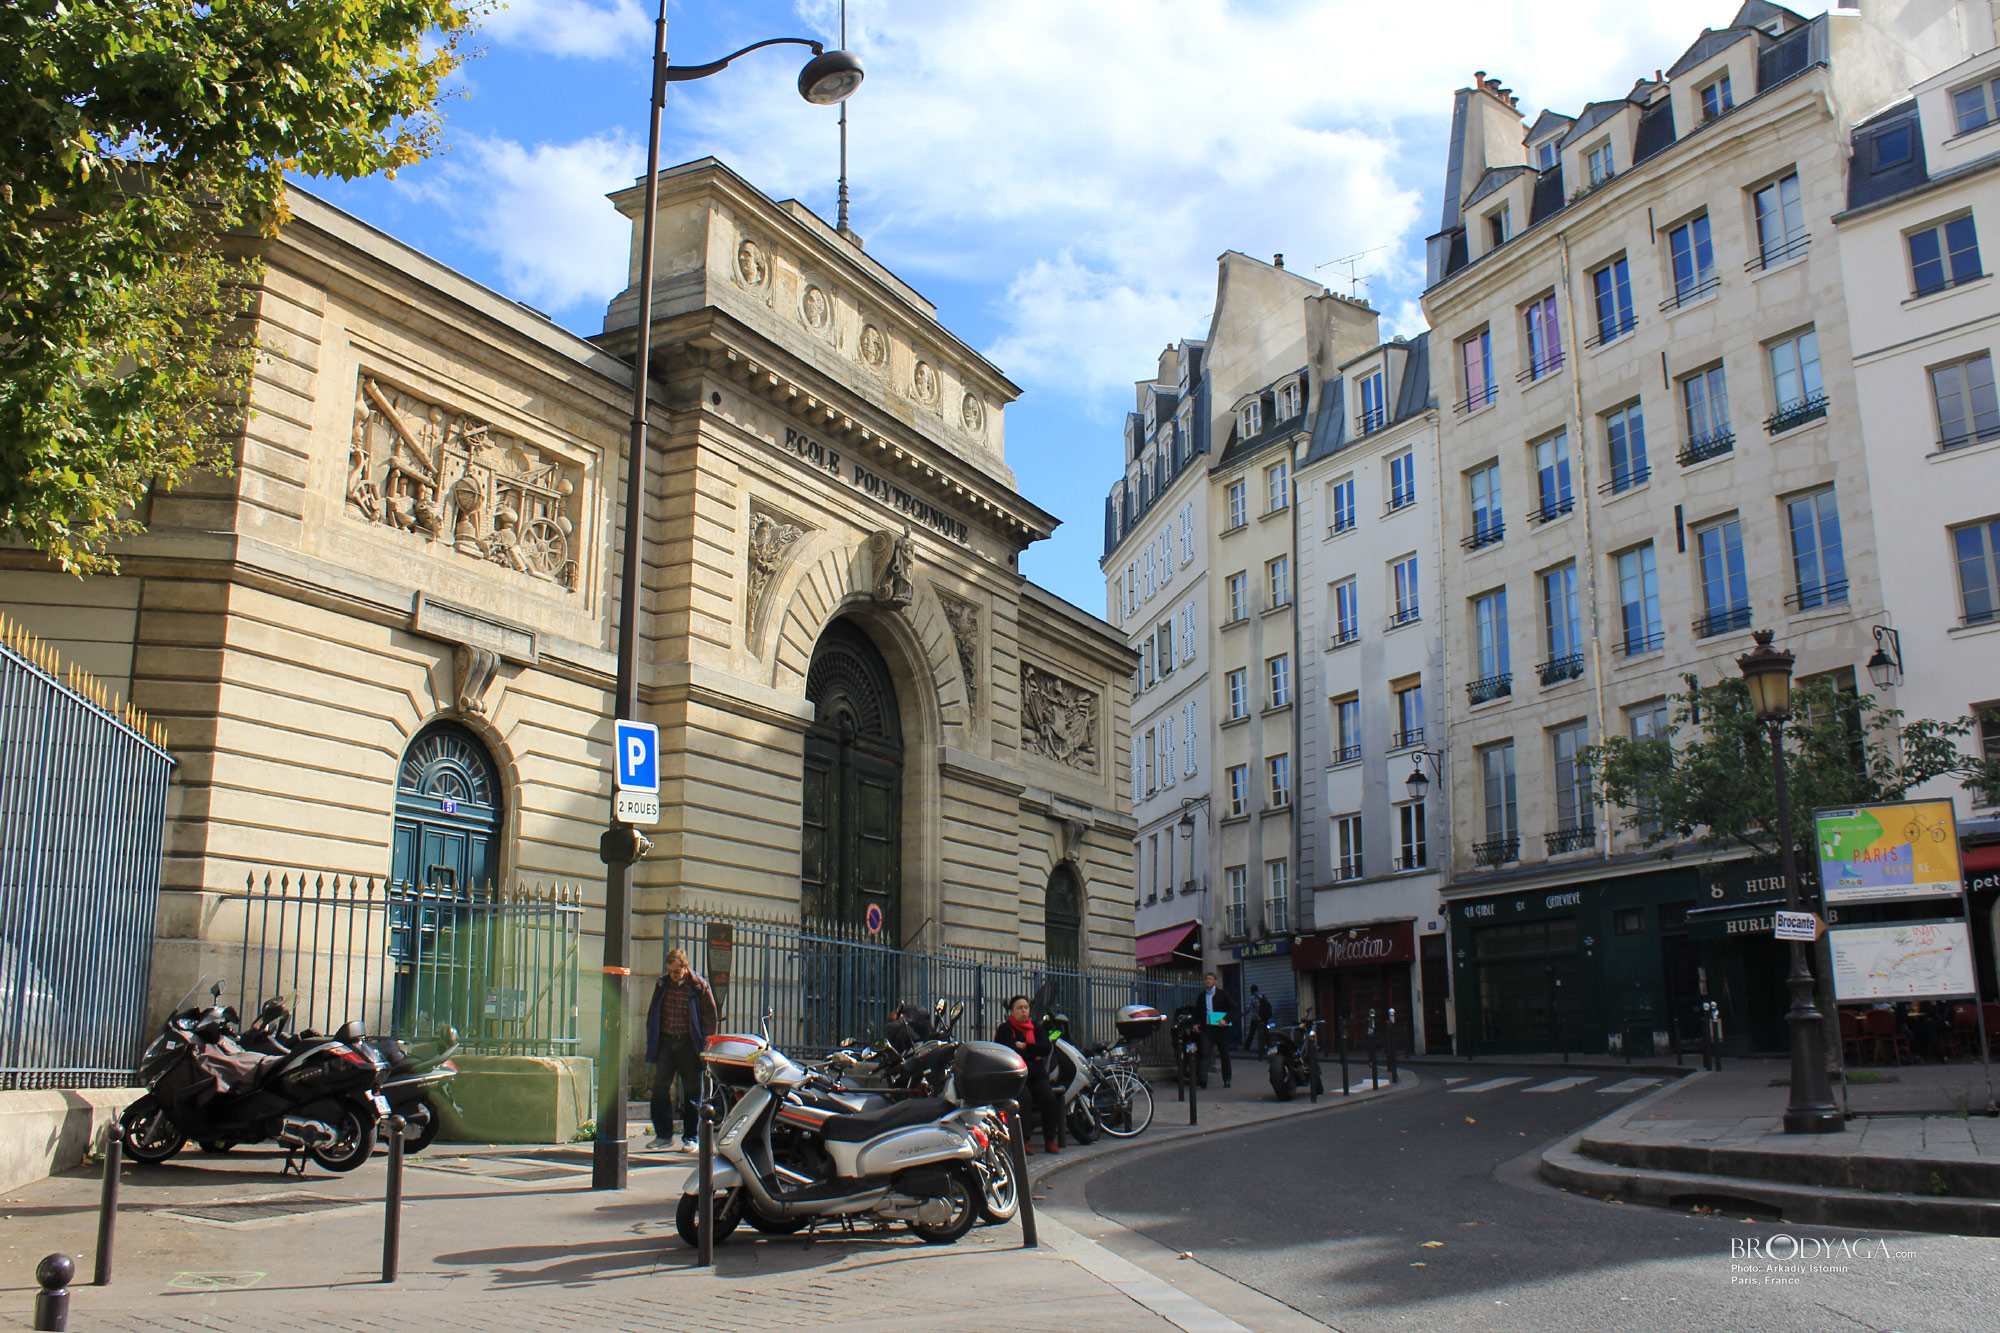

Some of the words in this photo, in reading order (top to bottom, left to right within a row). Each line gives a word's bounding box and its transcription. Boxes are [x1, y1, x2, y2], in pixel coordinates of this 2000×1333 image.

[785, 427, 840, 475] ECOLE
[854, 464, 969, 544] POLYTECHNIQUE
[627, 736, 646, 776] P
[447, 802, 453, 813] 5
[619, 801, 625, 812] 2
[628, 802, 657, 815] ROUES
[1853, 846, 1899, 864] PARIS
[1777, 913, 1815, 929] Brocante
[1241, 947, 1250, 957] LA
